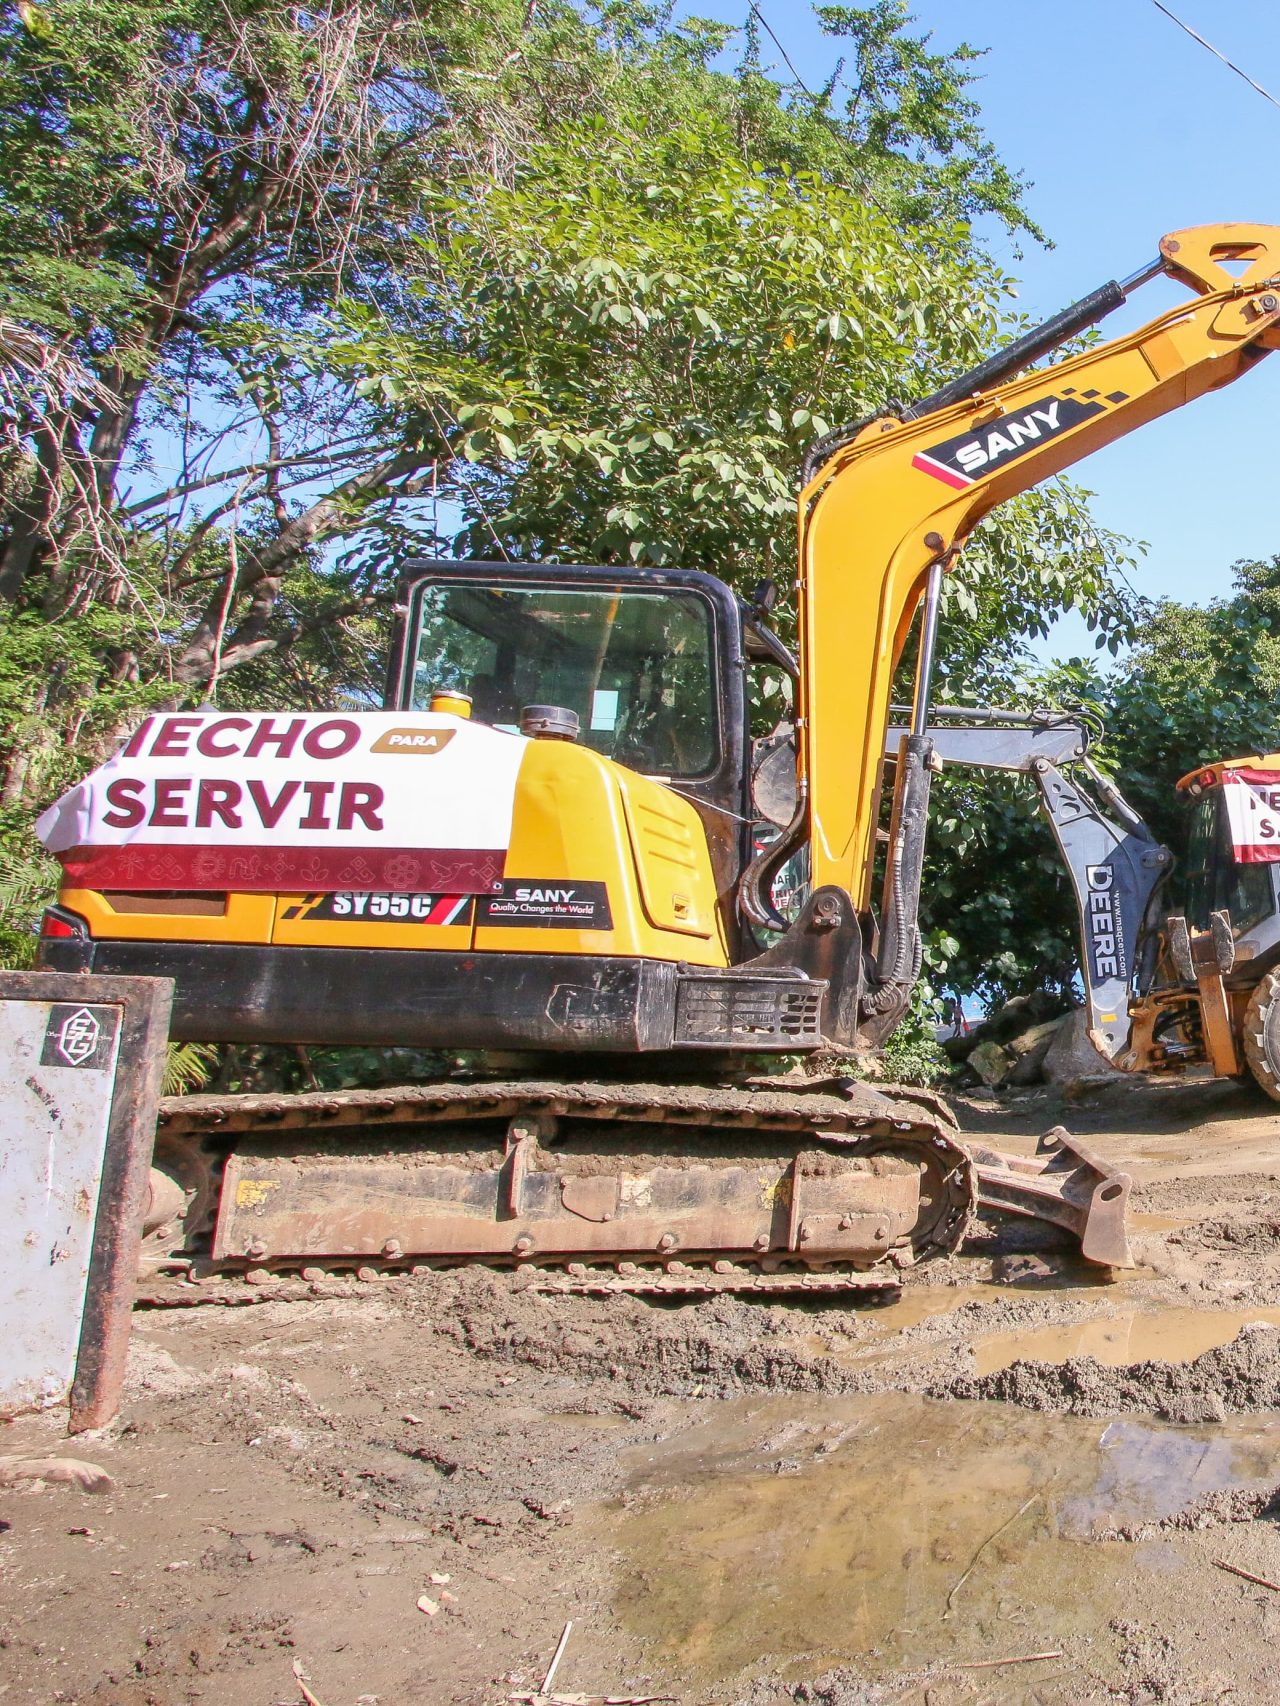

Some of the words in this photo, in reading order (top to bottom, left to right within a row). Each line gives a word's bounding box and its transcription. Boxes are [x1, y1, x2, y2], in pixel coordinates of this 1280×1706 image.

[955, 400, 1061, 473] SANY
[388, 734, 438, 747] PARA
[102, 778, 386, 831] SERVIR
[333, 890, 432, 917] SY55C
[490, 903, 519, 914] Quality
[520, 903, 554, 914] Changes
[555, 904, 567, 913] the
[569, 906, 594, 914] World
[515, 889, 576, 903] SANY
[1087, 866, 1117, 977] DEERE
[1113, 890, 1127, 977] www.maqcon.com
